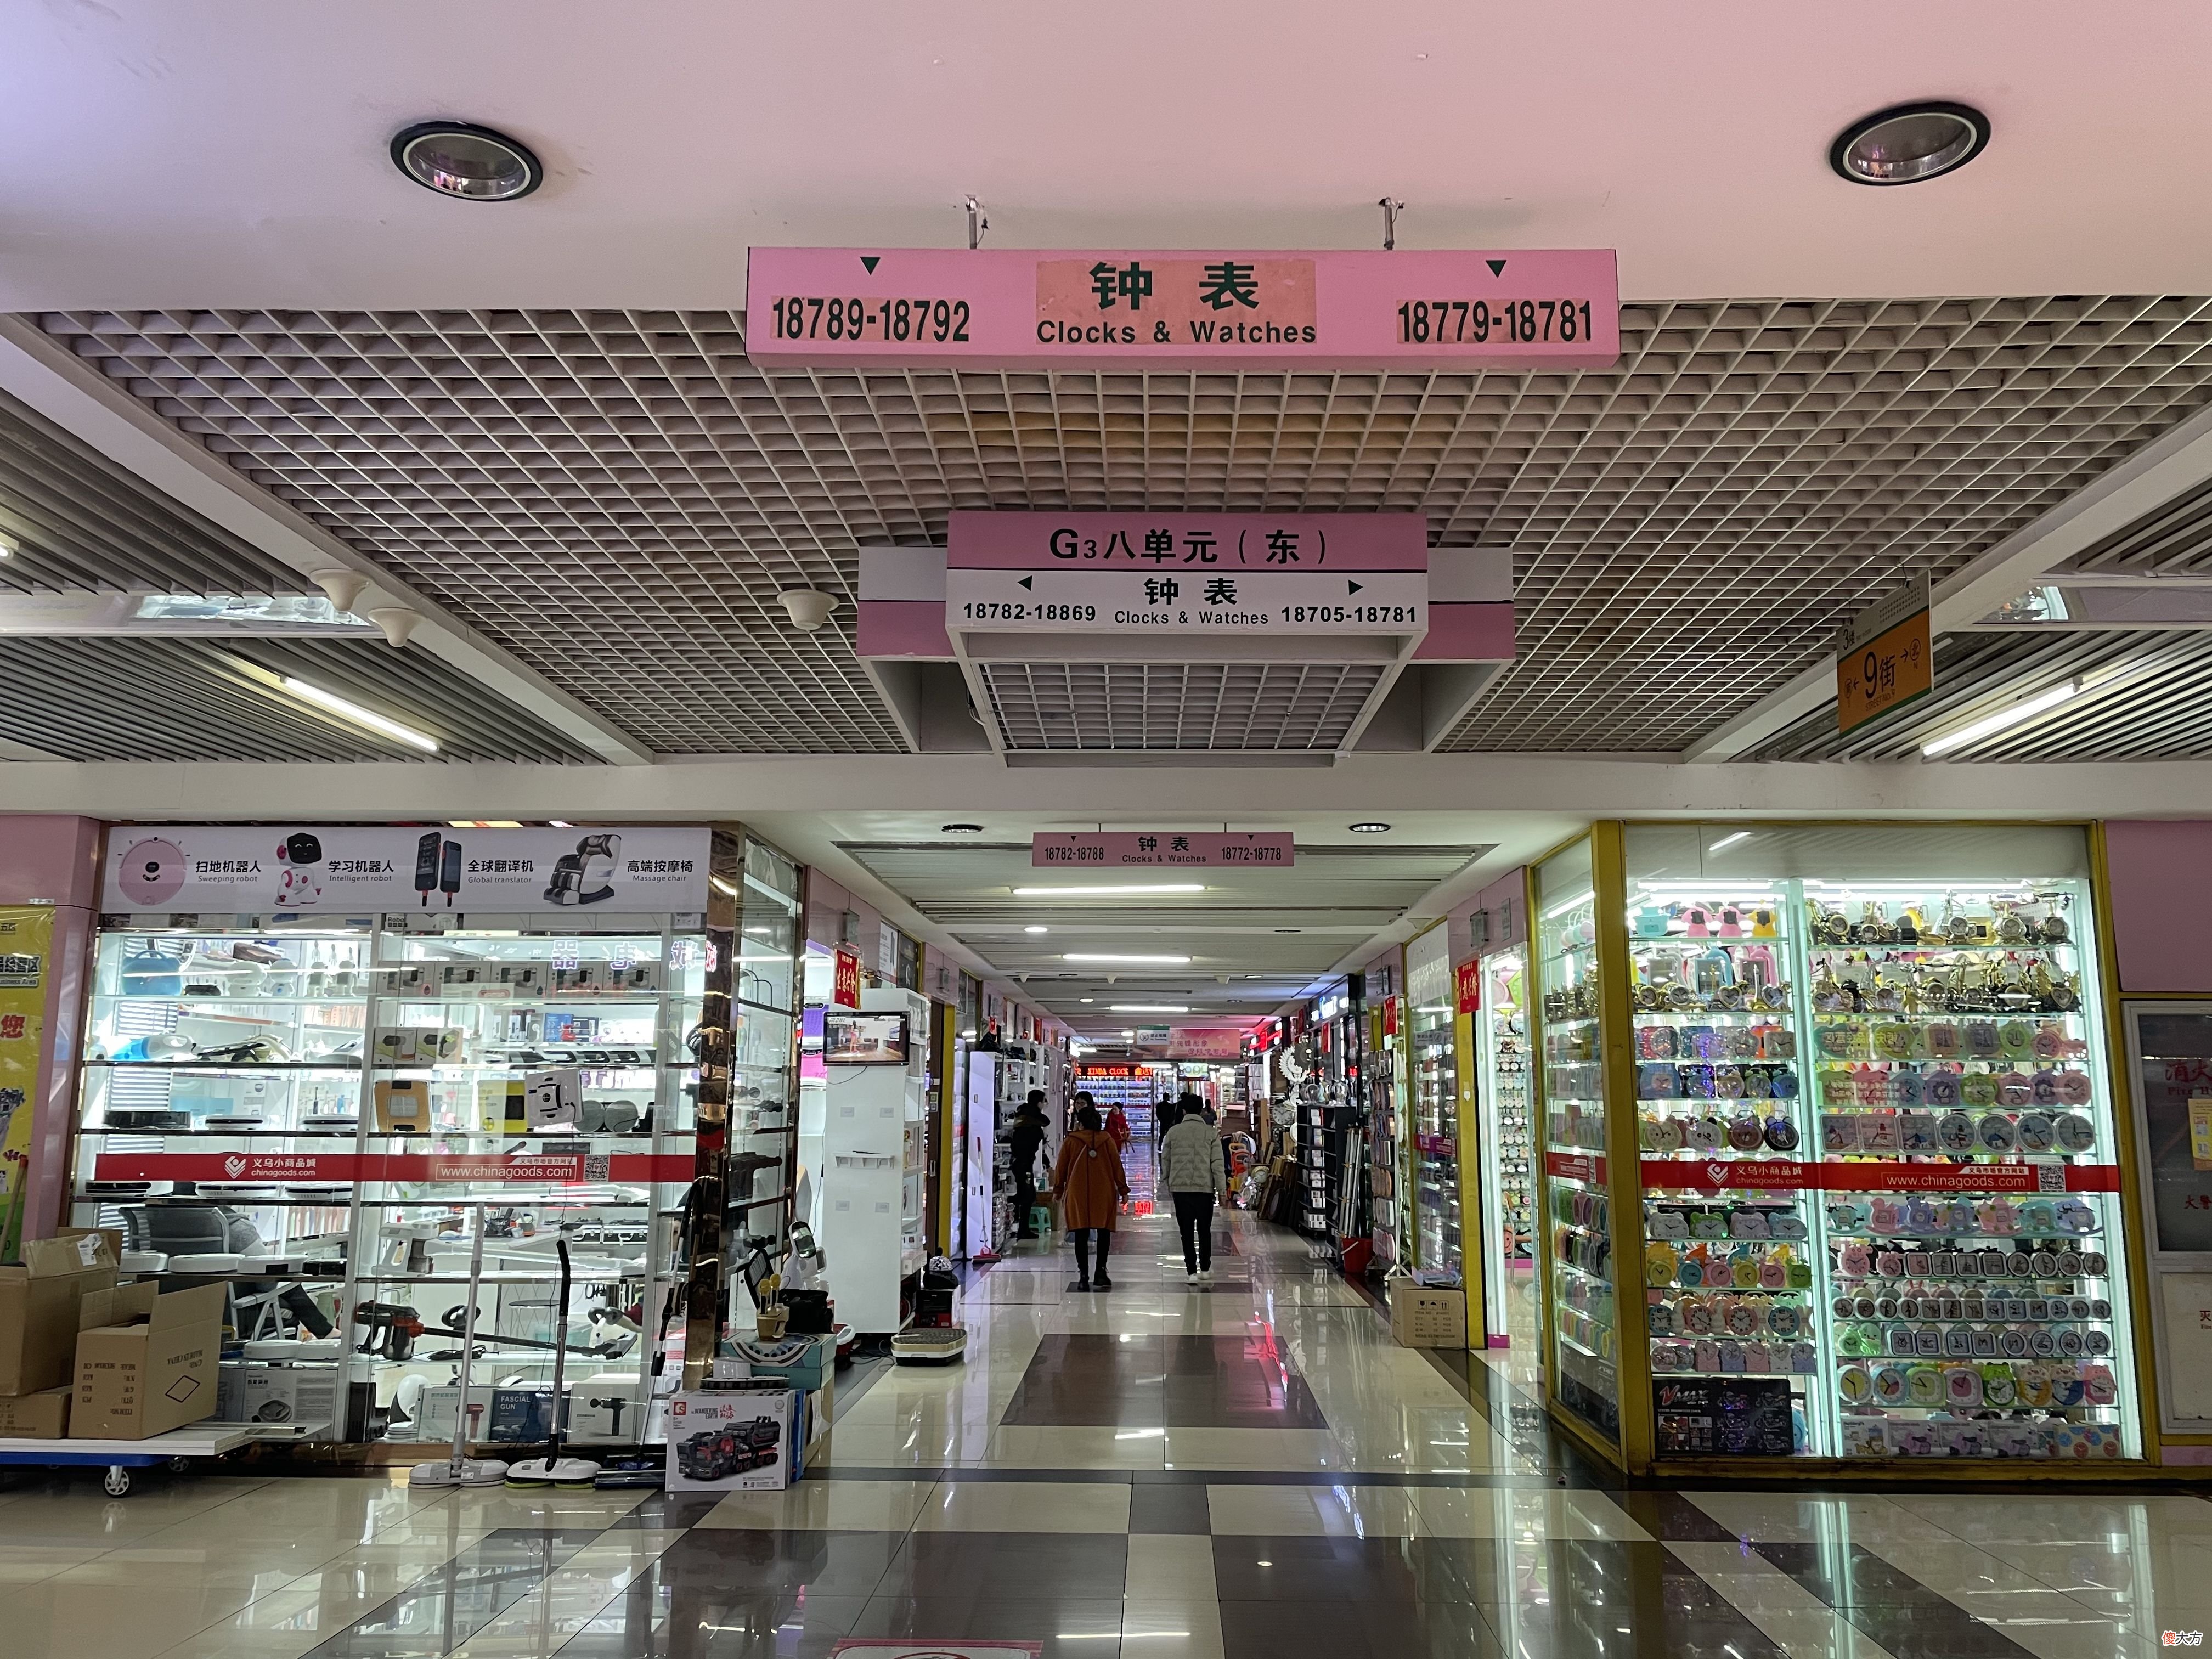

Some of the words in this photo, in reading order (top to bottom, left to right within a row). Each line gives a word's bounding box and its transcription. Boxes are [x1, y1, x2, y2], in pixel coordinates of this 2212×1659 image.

[1089, 262, 1259, 311] 钟表
[774, 297, 969, 342] 18789-18792
[1399, 300, 1590, 343] 18779-18781
[1037, 321, 1135, 343] Clocks
[1154, 321, 1171, 342] &
[1190, 321, 1316, 343] Watches
[1144, 578, 1237, 605] 钟表
[964, 603, 1095, 621] 18782-18869
[1115, 611, 1168, 624] Clocks
[1179, 611, 1188, 623] &
[1199, 612, 1268, 624] Watches
[1282, 607, 1414, 622] 18705-18781
[1864, 651, 1895, 699] 9街
[1138, 837, 1189, 851] 钟表
[1045, 847, 1103, 860] 18782-18788
[1222, 847, 1281, 860] 18772-18778
[196, 861, 261, 872] 扫地机器人
[329, 860, 393, 872] 学习机器人
[468, 860, 533, 872] 全球翻译机
[628, 860, 693, 872] 高端按摩椅
[252, 1158, 316, 1168] 义乌小商品城
[251, 1169, 315, 1177] chinagoods.com
[441, 1165, 573, 1180] www.chinagoods.com
[1736, 1166, 1803, 1176] 义乌小商品城
[1736, 1177, 1803, 1186] chinagoods.com
[1887, 1175, 2025, 1189] www.chinagoods.com
